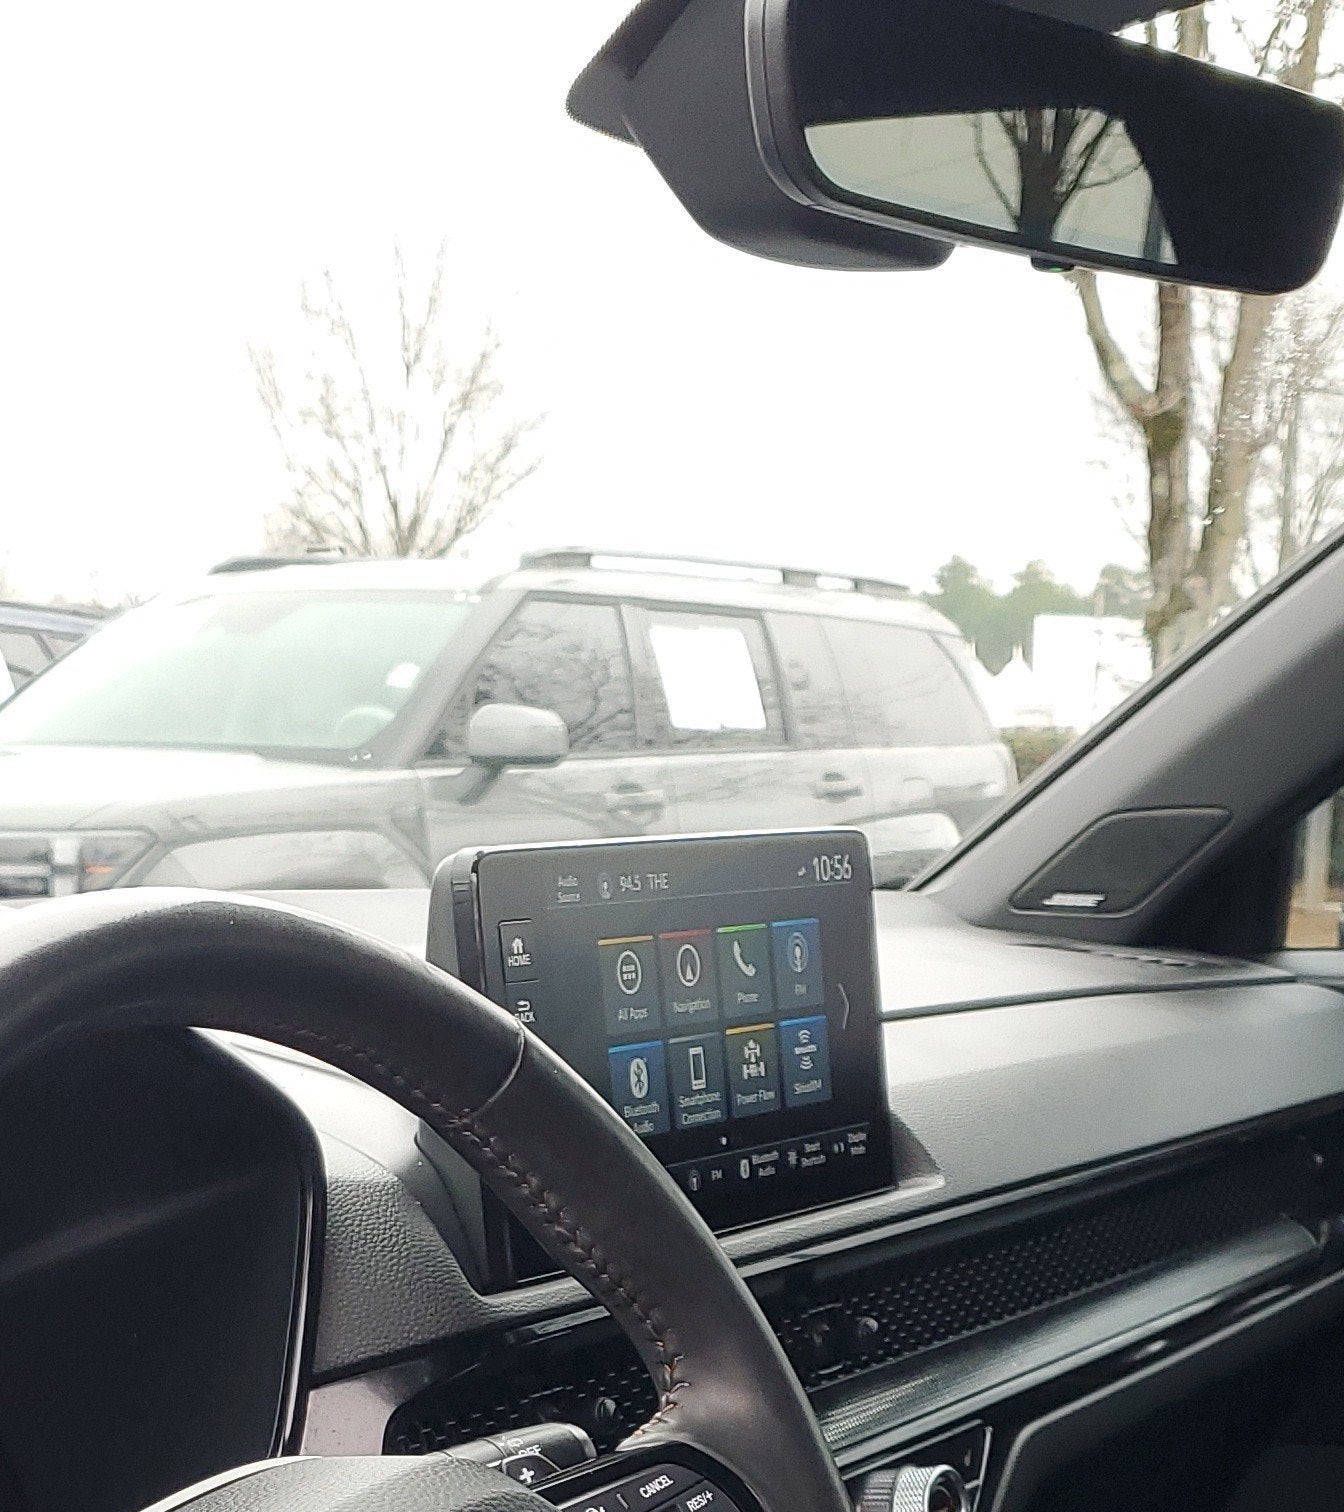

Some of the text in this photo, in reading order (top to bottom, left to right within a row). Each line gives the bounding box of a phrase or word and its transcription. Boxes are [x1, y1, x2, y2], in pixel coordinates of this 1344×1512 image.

[813, 855, 852, 882] 10:56
[647, 873, 669, 890] THE
[508, 954, 532, 967] HOME
[639, 1474, 675, 1500] CANCEL
